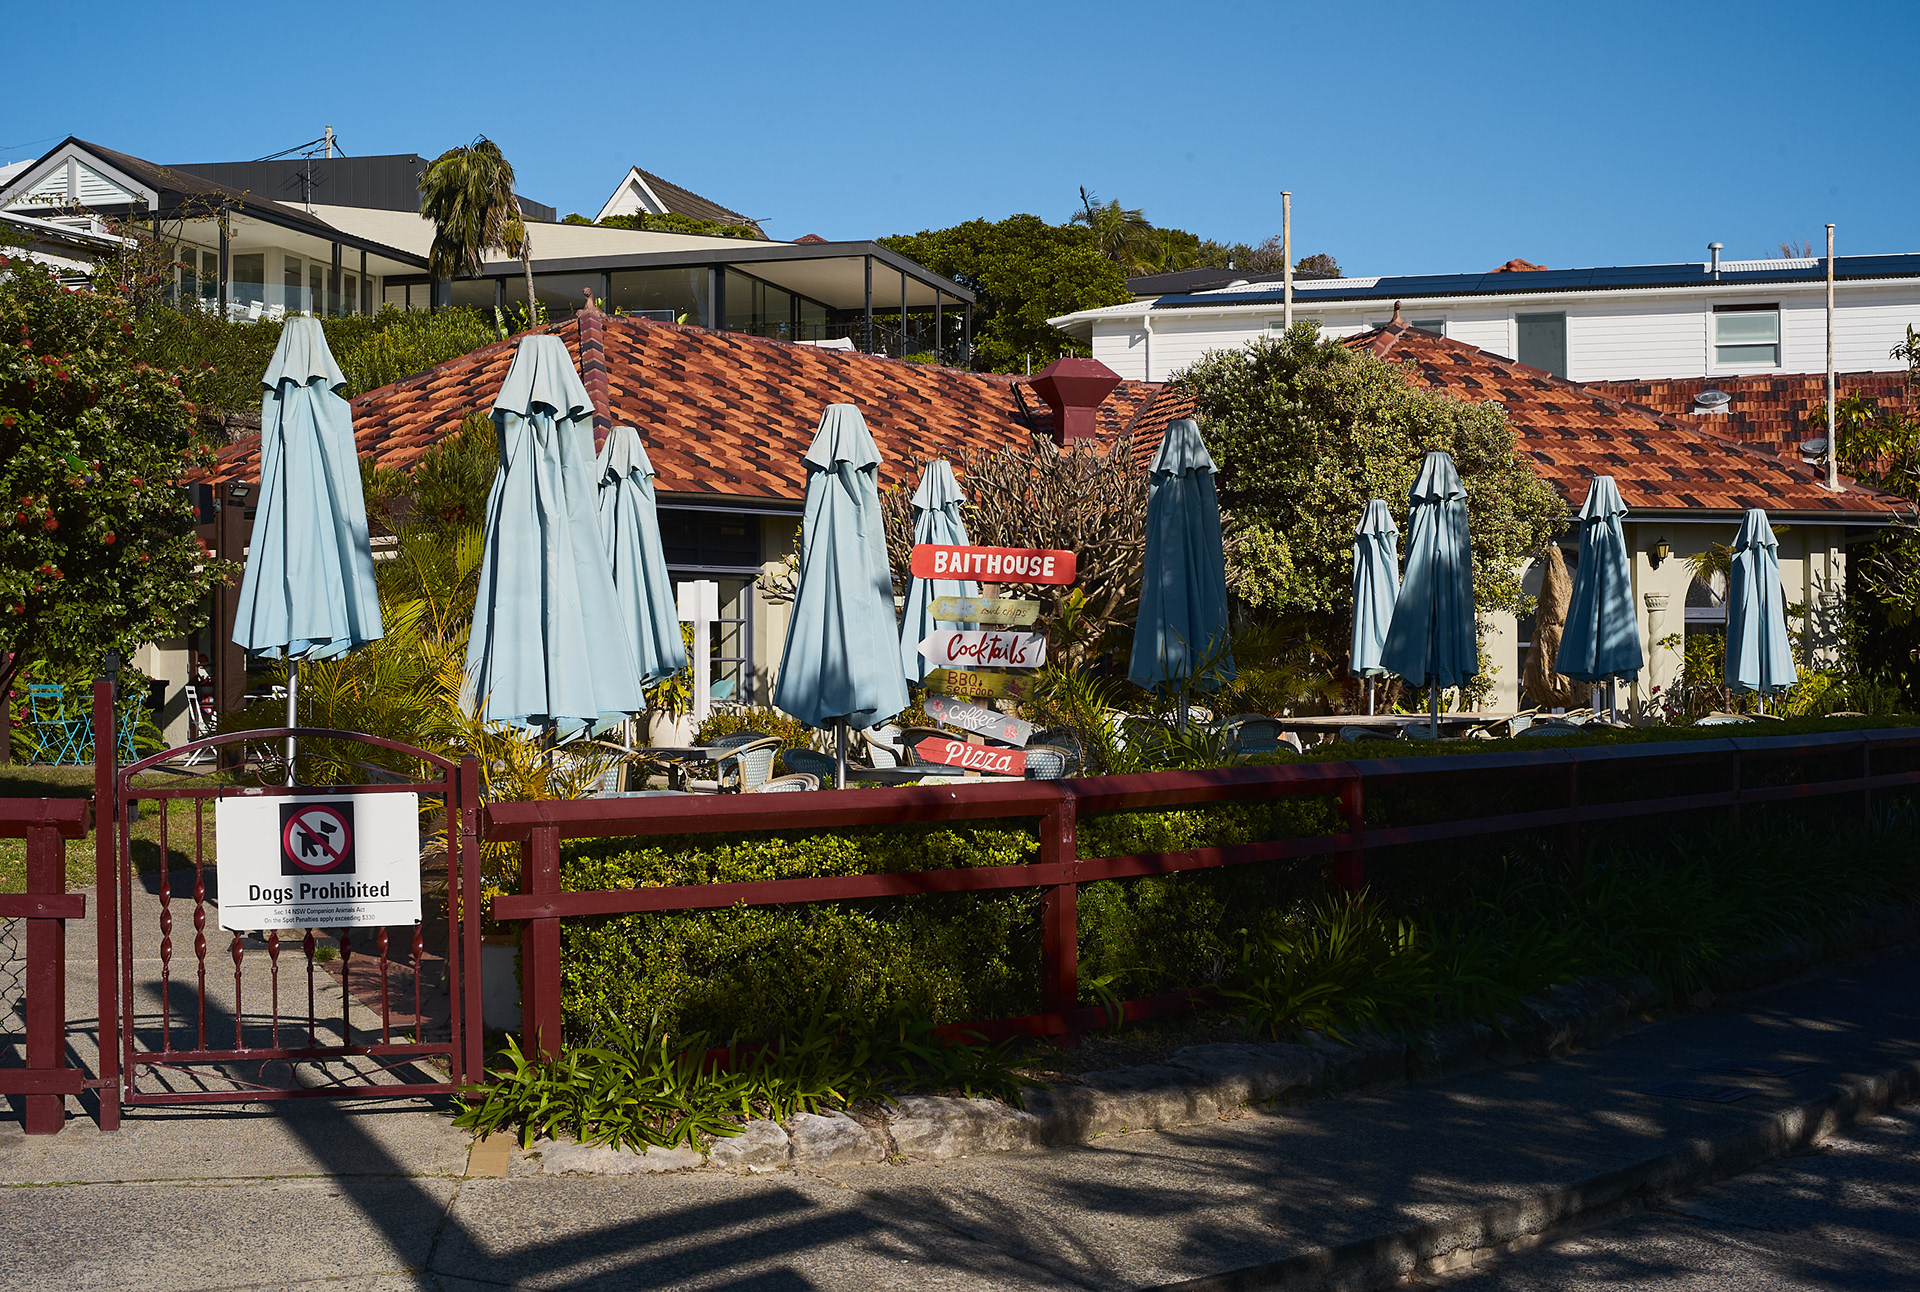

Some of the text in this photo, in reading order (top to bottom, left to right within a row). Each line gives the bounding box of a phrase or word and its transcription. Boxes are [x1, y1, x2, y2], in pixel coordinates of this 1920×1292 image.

[934, 551, 1055, 577] BAITHOUSE
[1002, 604, 1028, 621] chips
[947, 632, 1027, 664] Cocktails
[947, 671, 977, 687] BBQ
[948, 705, 997, 730] Coffee
[945, 741, 1012, 771] Pizza
[249, 881, 389, 904] Dogs Prohibited
[306, 906, 334, 915] Companion
